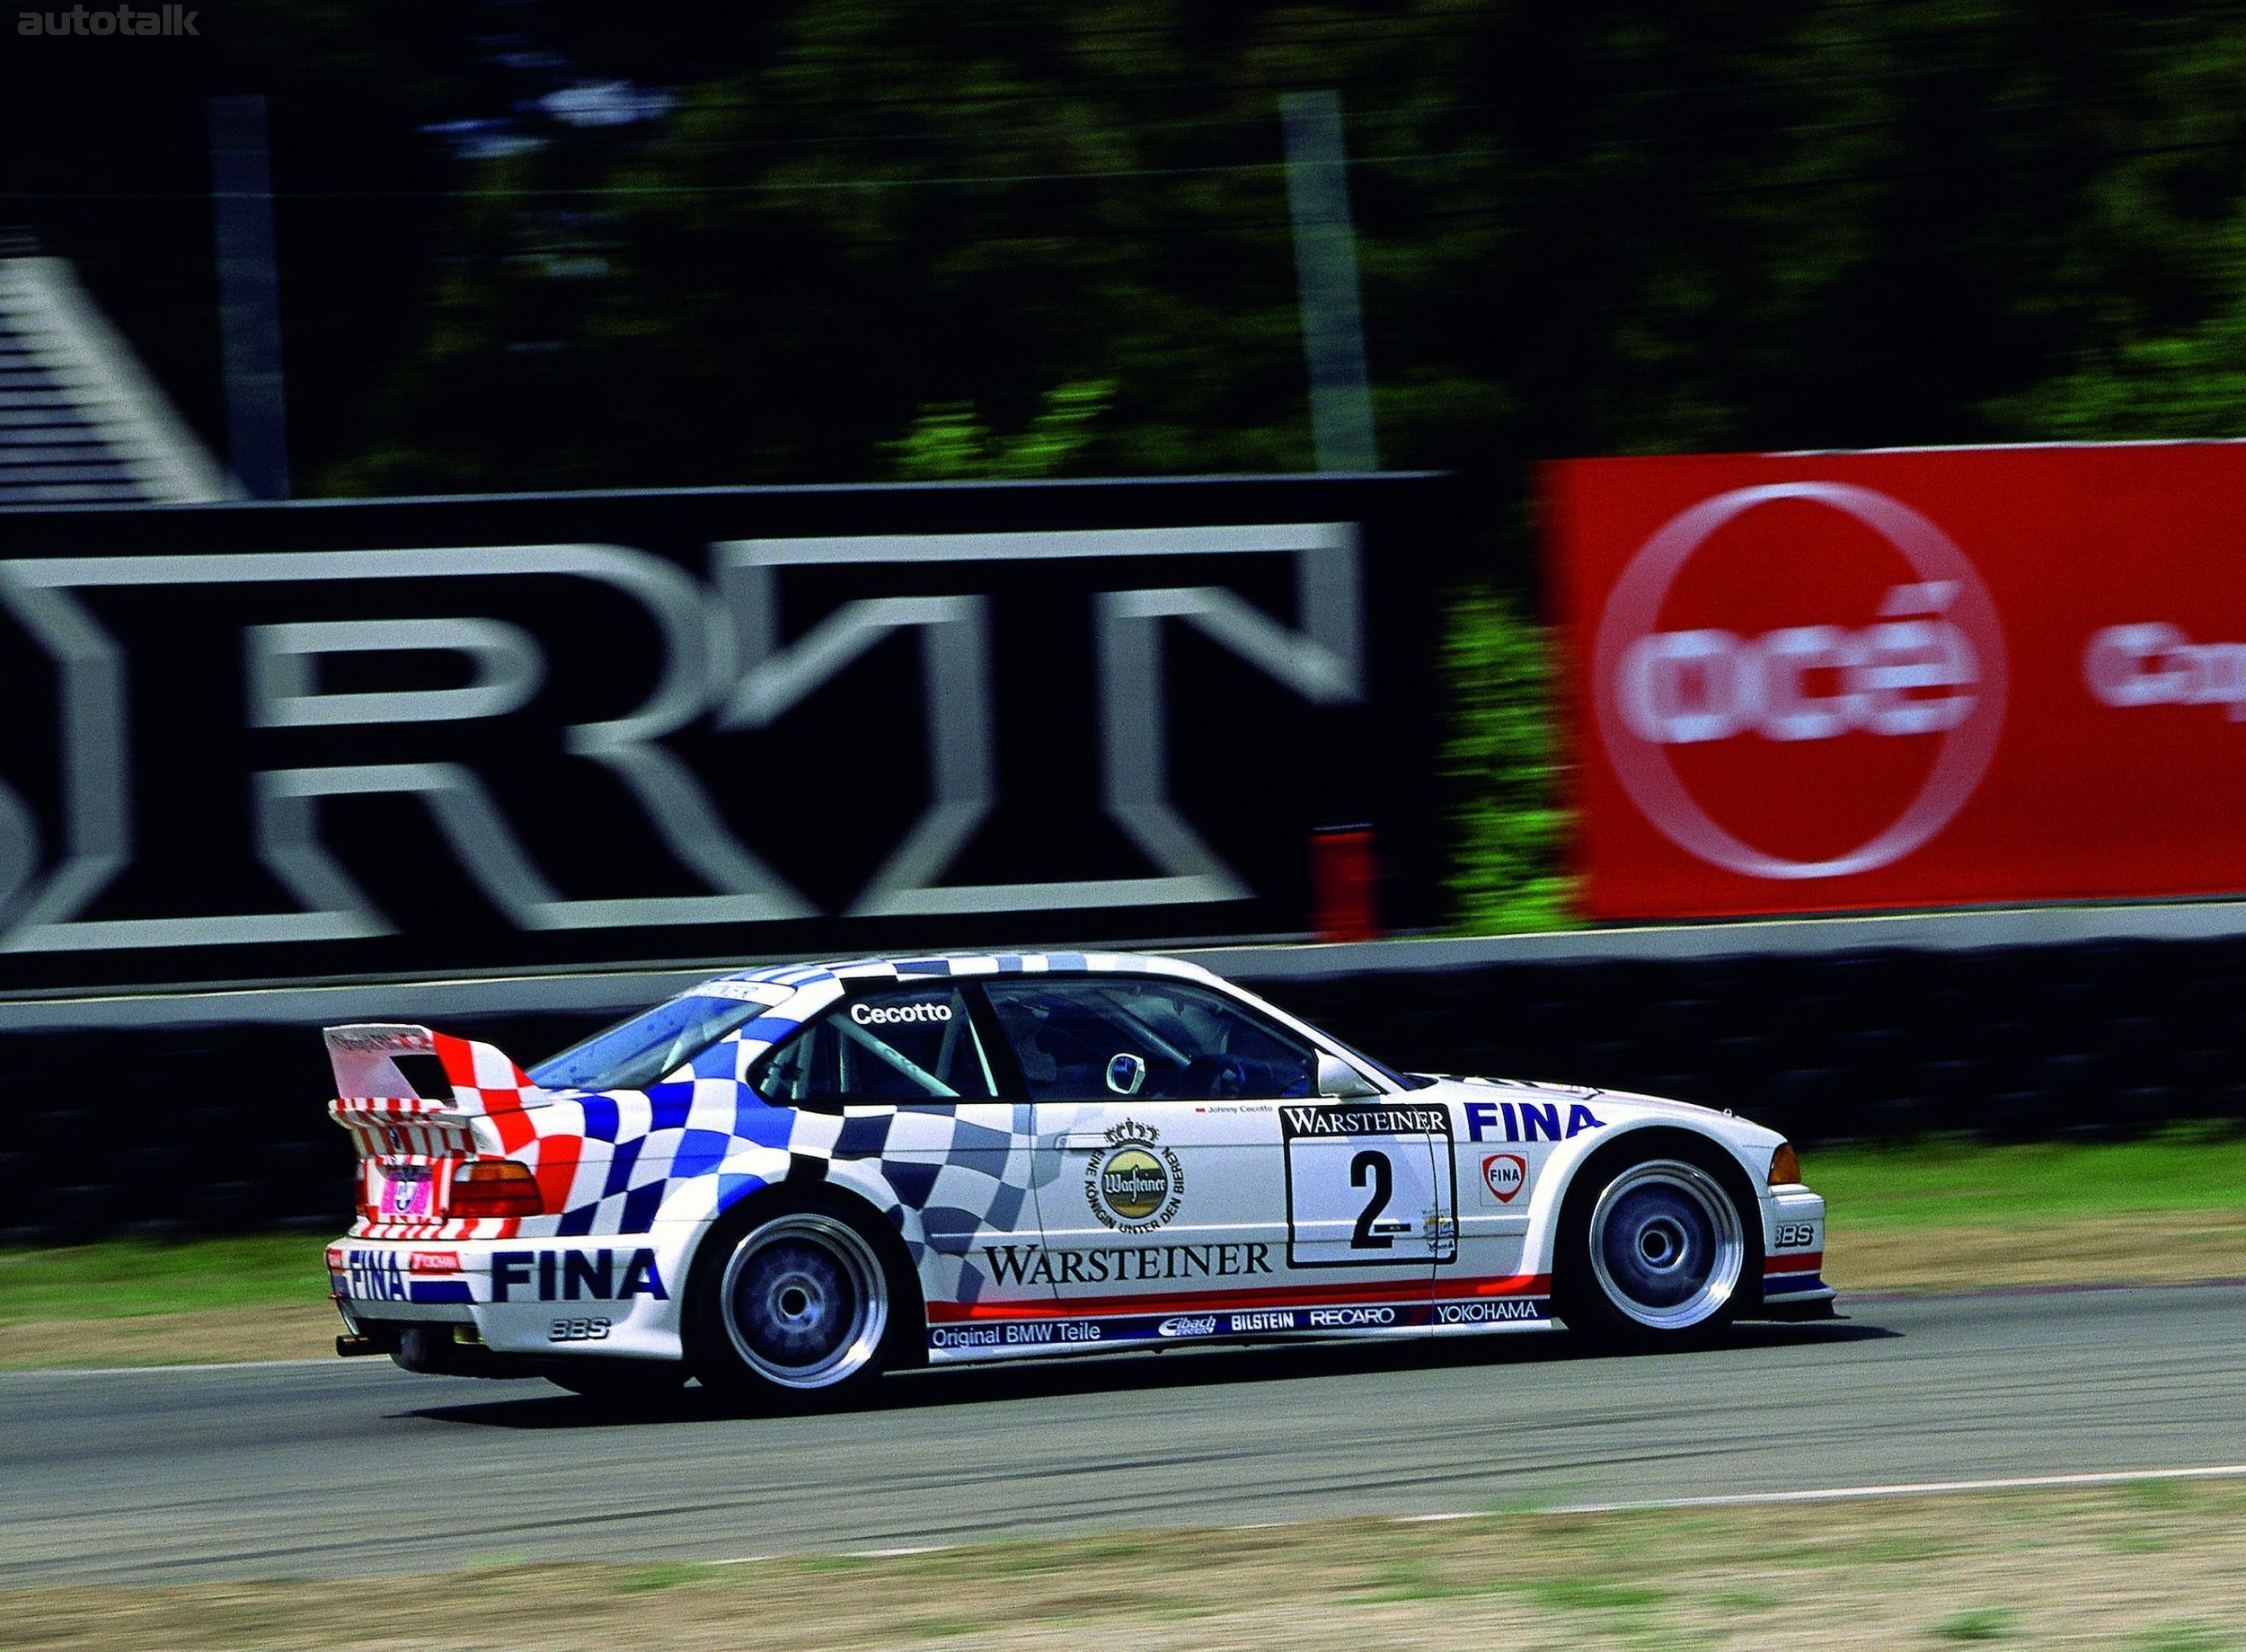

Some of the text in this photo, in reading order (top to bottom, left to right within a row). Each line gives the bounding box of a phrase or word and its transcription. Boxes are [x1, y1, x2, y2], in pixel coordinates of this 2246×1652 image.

[0, 521, 1366, 954] RT
[850, 1003, 953, 1026] Cecotto
[1282, 1107, 1447, 1134] WARSTEINER
[1463, 1101, 1607, 1142] FINA
[1085, 1149, 1106, 1176] EINE
[1161, 1145, 1184, 1195] BIEREN
[1490, 1168, 1520, 1183] FINA
[1160, 1197, 1183, 1224] DEN
[1350, 1150, 1393, 1250] 2
[1119, 1219, 1162, 1235] UNTER
[349, 1250, 411, 1301] FINA
[491, 1248, 669, 1303] FINA
[984, 1241, 1273, 1286] WARSTEINER
[1231, 1312, 1295, 1331] BILSTEIN
[1309, 1307, 1395, 1327] RECARO
[1437, 1301, 1538, 1323] YOKOHAMA
[548, 1317, 612, 1342] BBS
[932, 1322, 1101, 1347] Original BMW Teile
[1158, 1315, 1216, 1337] Eibach
